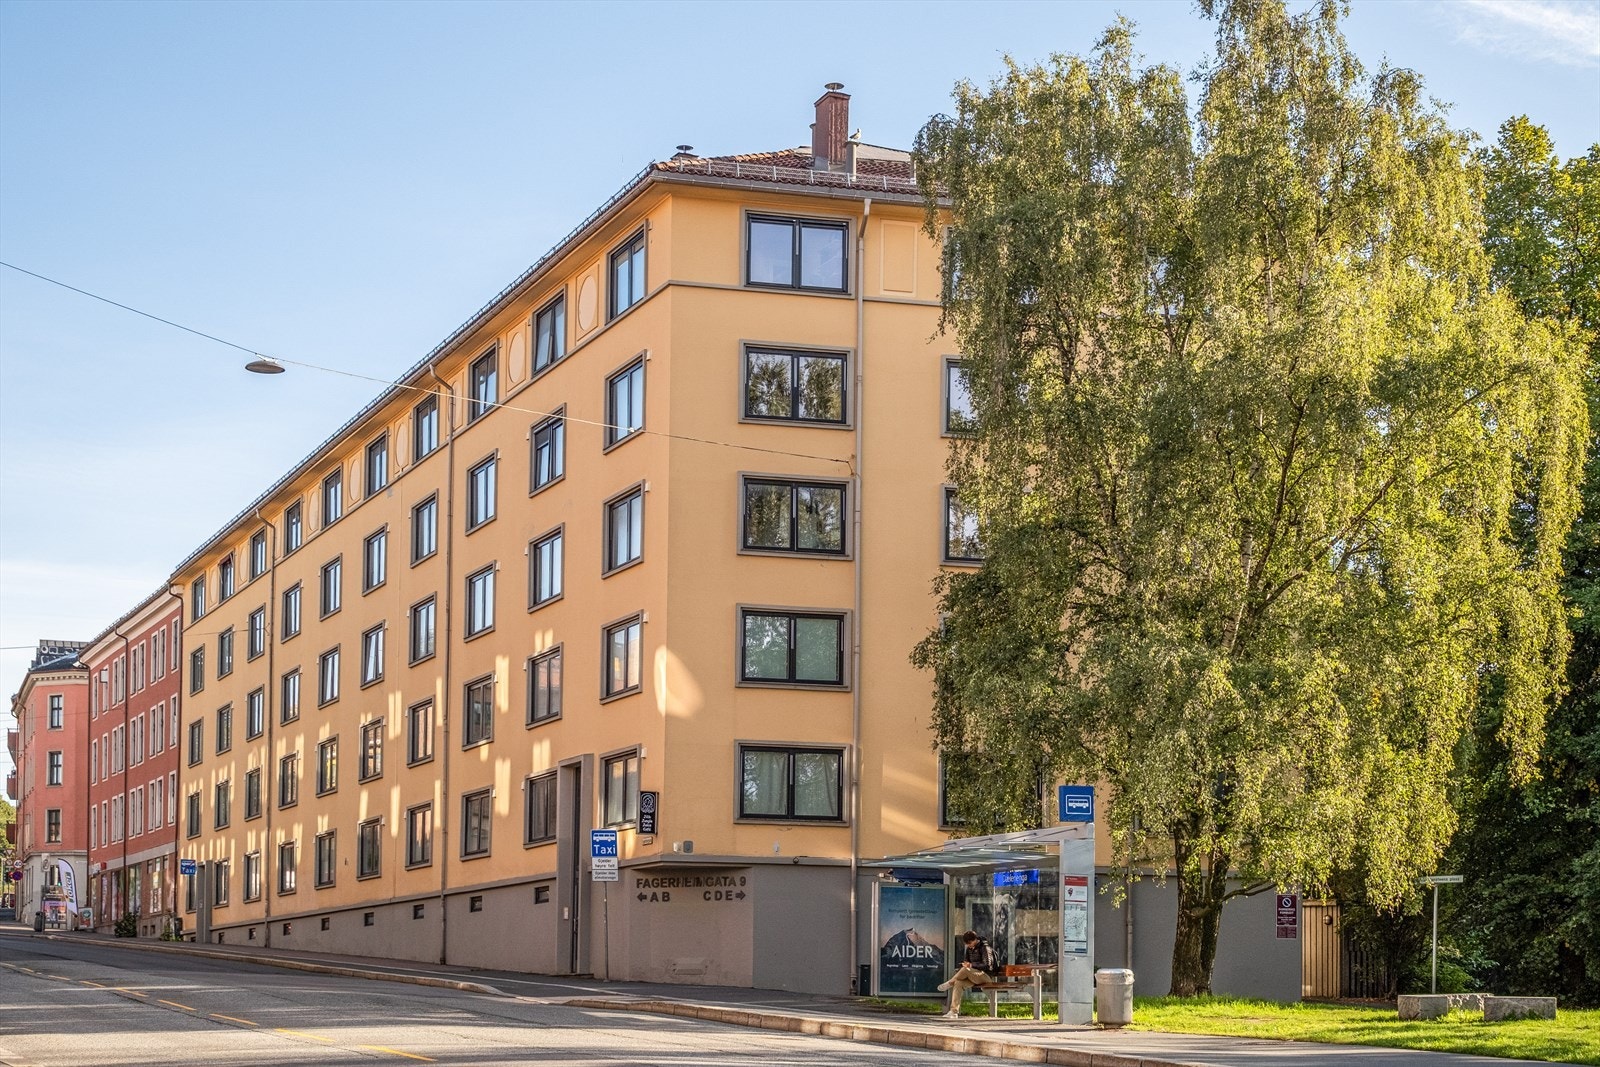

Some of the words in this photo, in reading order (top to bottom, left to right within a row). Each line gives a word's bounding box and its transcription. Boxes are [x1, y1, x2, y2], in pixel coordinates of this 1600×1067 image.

[593, 844, 616, 855] Taxi
[739, 876, 747, 887] 9
[891, 945, 934, 958] AIDER
